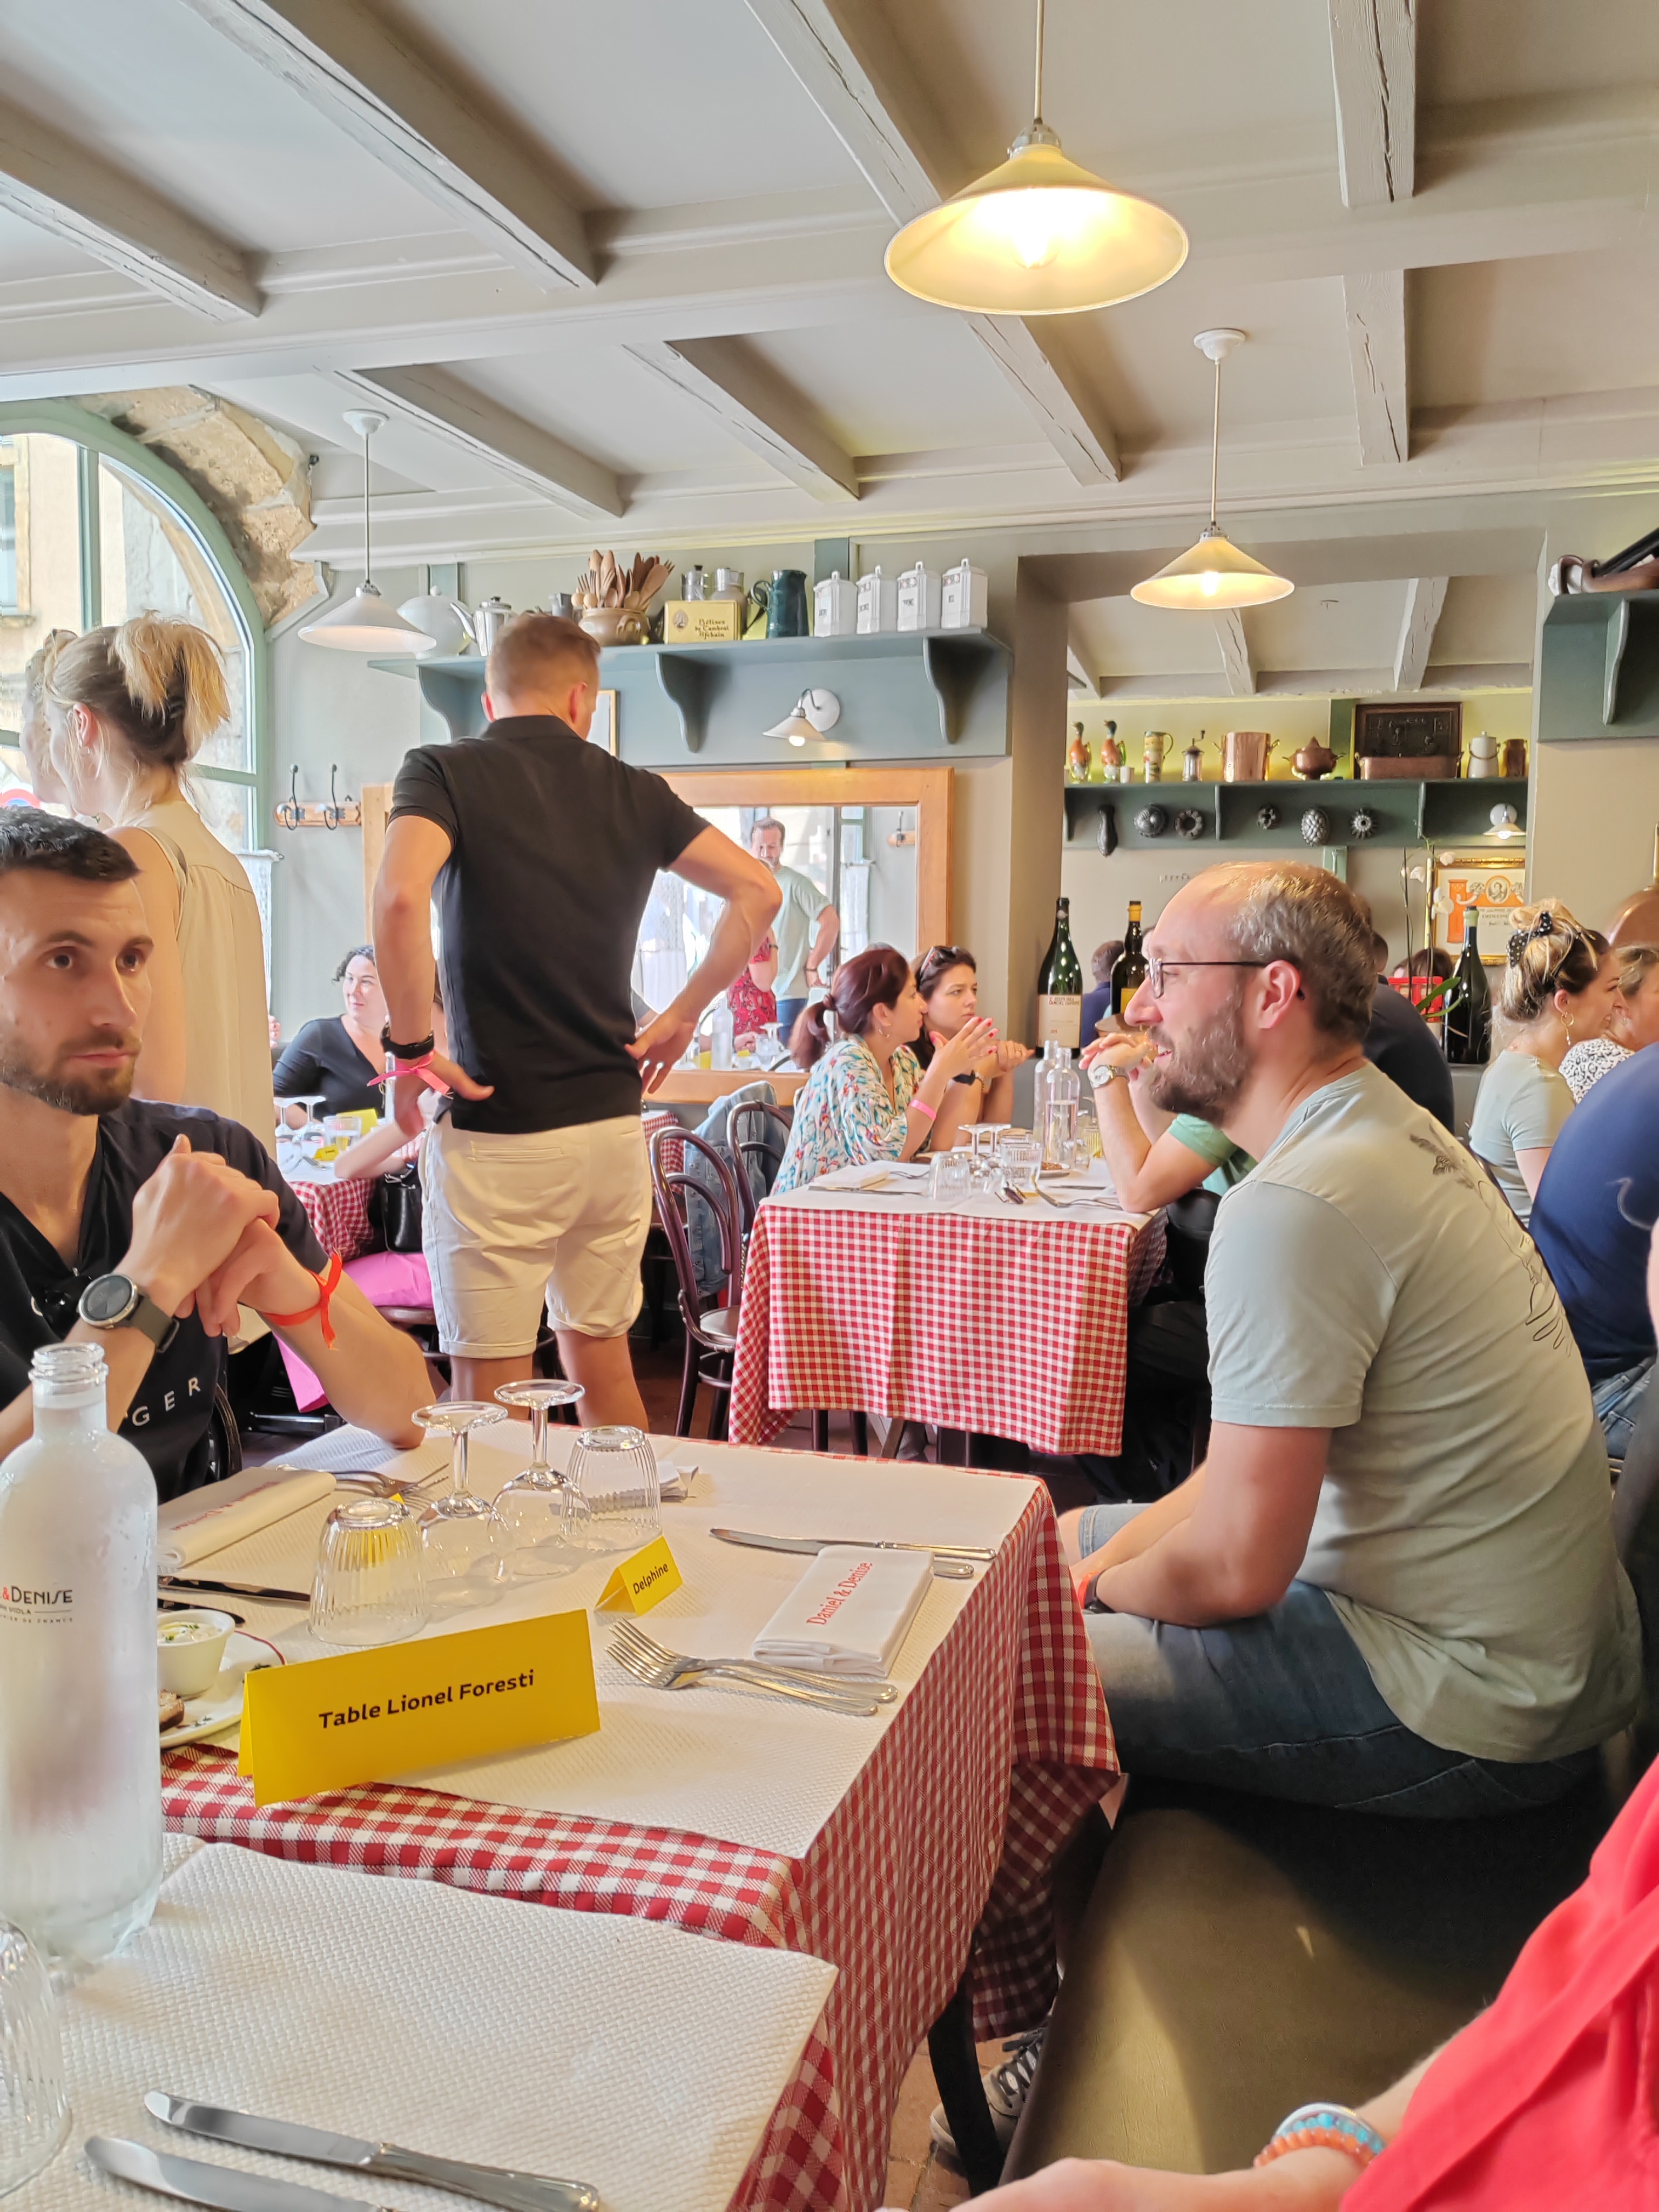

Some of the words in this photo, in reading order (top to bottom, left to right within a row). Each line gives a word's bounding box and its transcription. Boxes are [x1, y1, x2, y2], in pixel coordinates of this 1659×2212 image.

[124, 1377, 201, 1427] GER
[633, 1563, 669, 1594] Delphine
[806, 1596, 846, 1625] Daniel
[838, 1562, 873, 1588] Denise
[319, 1704, 381, 1729] Table
[387, 1686, 453, 1715] Lionel
[459, 1669, 535, 1700] Foresti
